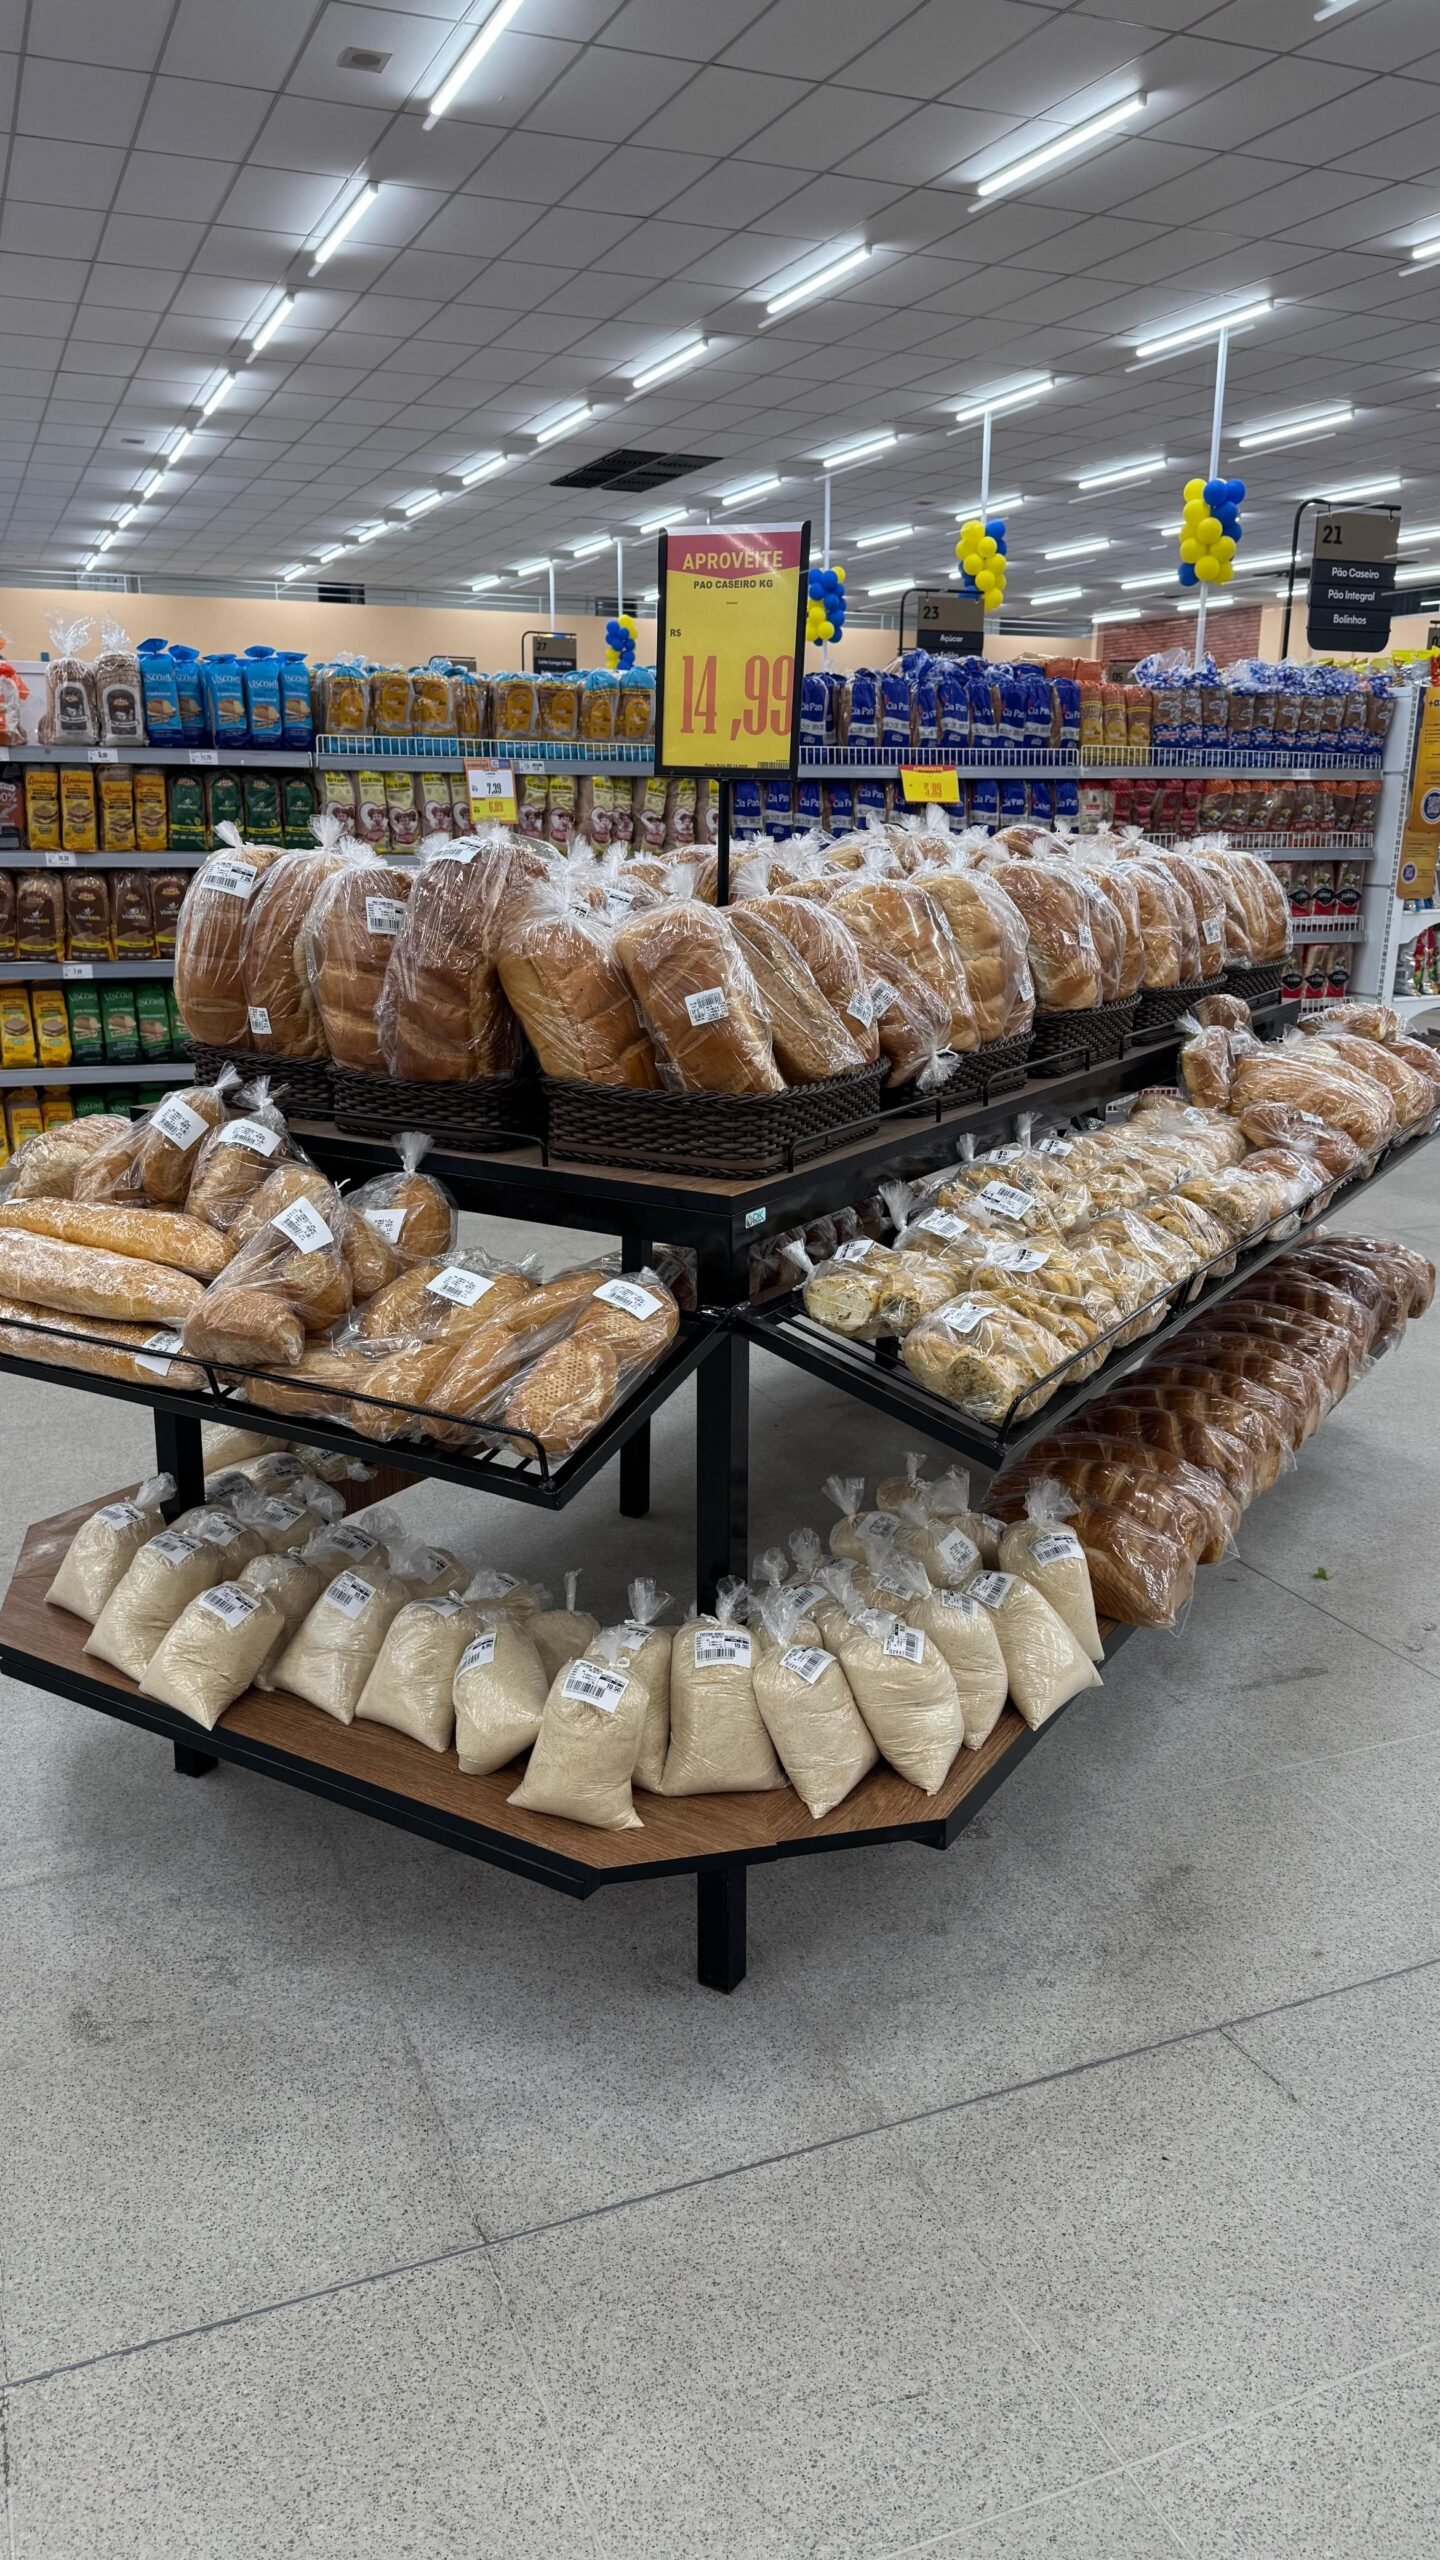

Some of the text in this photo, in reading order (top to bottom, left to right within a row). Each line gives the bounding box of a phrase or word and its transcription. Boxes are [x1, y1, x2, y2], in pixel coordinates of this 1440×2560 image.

[1322, 525, 1343, 545] 21
[683, 550, 783, 570] APROVEITE
[1331, 566, 1380, 579] Pão Caseiro
[693, 579, 773, 589] PAO CASEIRO KG
[1328, 588, 1376, 603] Pão Integral
[923, 606, 939, 620] 23
[1333, 614, 1367, 625] Bolinhos
[670, 628, 682, 638] R$
[940, 634, 963, 643] Açúcar
[536, 642, 547, 651] 27
[1112, 672, 1124, 682] 05
